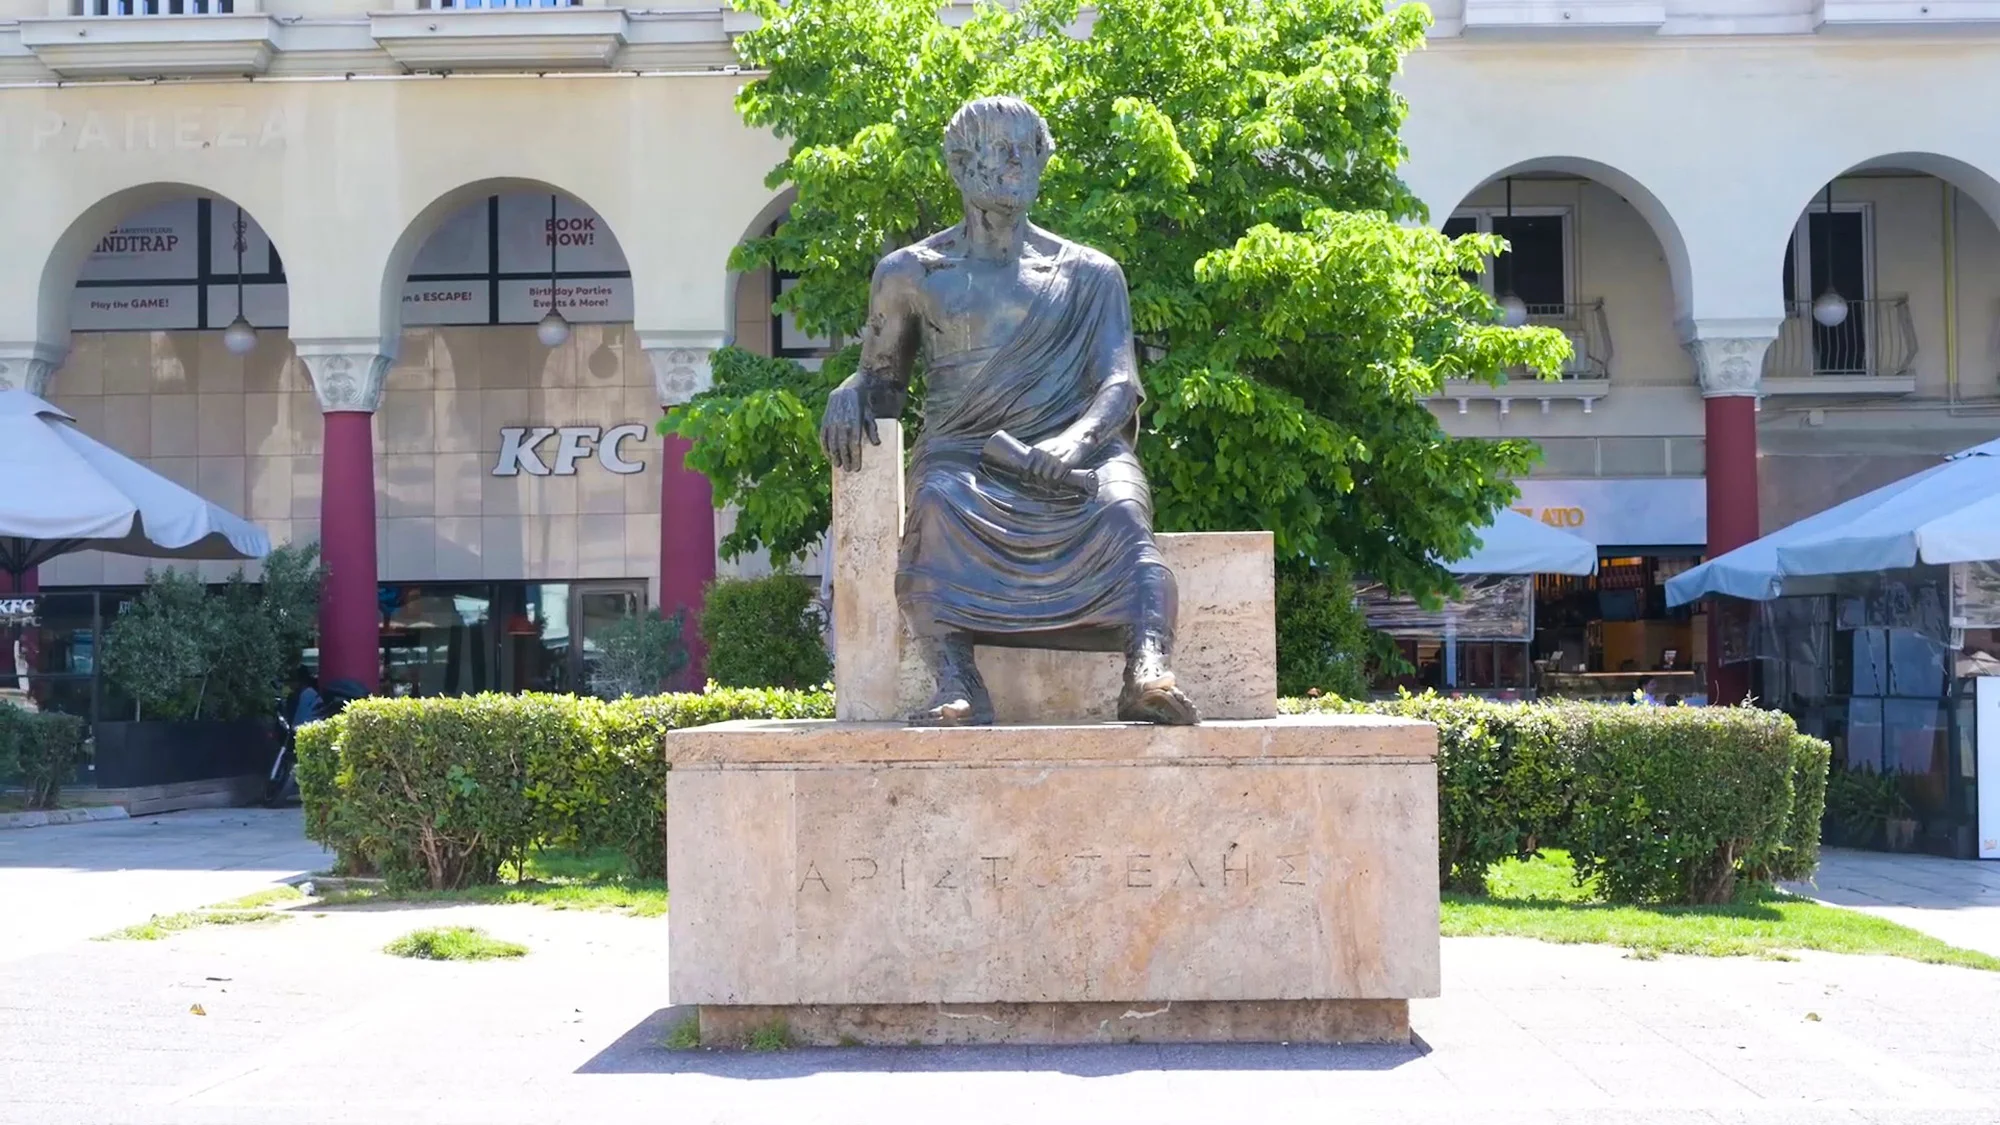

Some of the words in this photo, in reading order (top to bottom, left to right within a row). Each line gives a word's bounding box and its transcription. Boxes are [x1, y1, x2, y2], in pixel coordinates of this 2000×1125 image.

[0, 105, 287, 151] ΡΑΠΕΖΑ
[544, 218, 595, 232] BOOK
[545, 233, 594, 246] NOW!
[423, 291, 472, 302] ESCAPE!
[575, 285, 612, 296] Parties
[90, 301, 112, 311] Play
[113, 300, 129, 309] the
[131, 298, 169, 309] GAME!
[579, 299, 609, 307] More!
[492, 424, 648, 476] KFC
[0, 599, 35, 614] KFC
